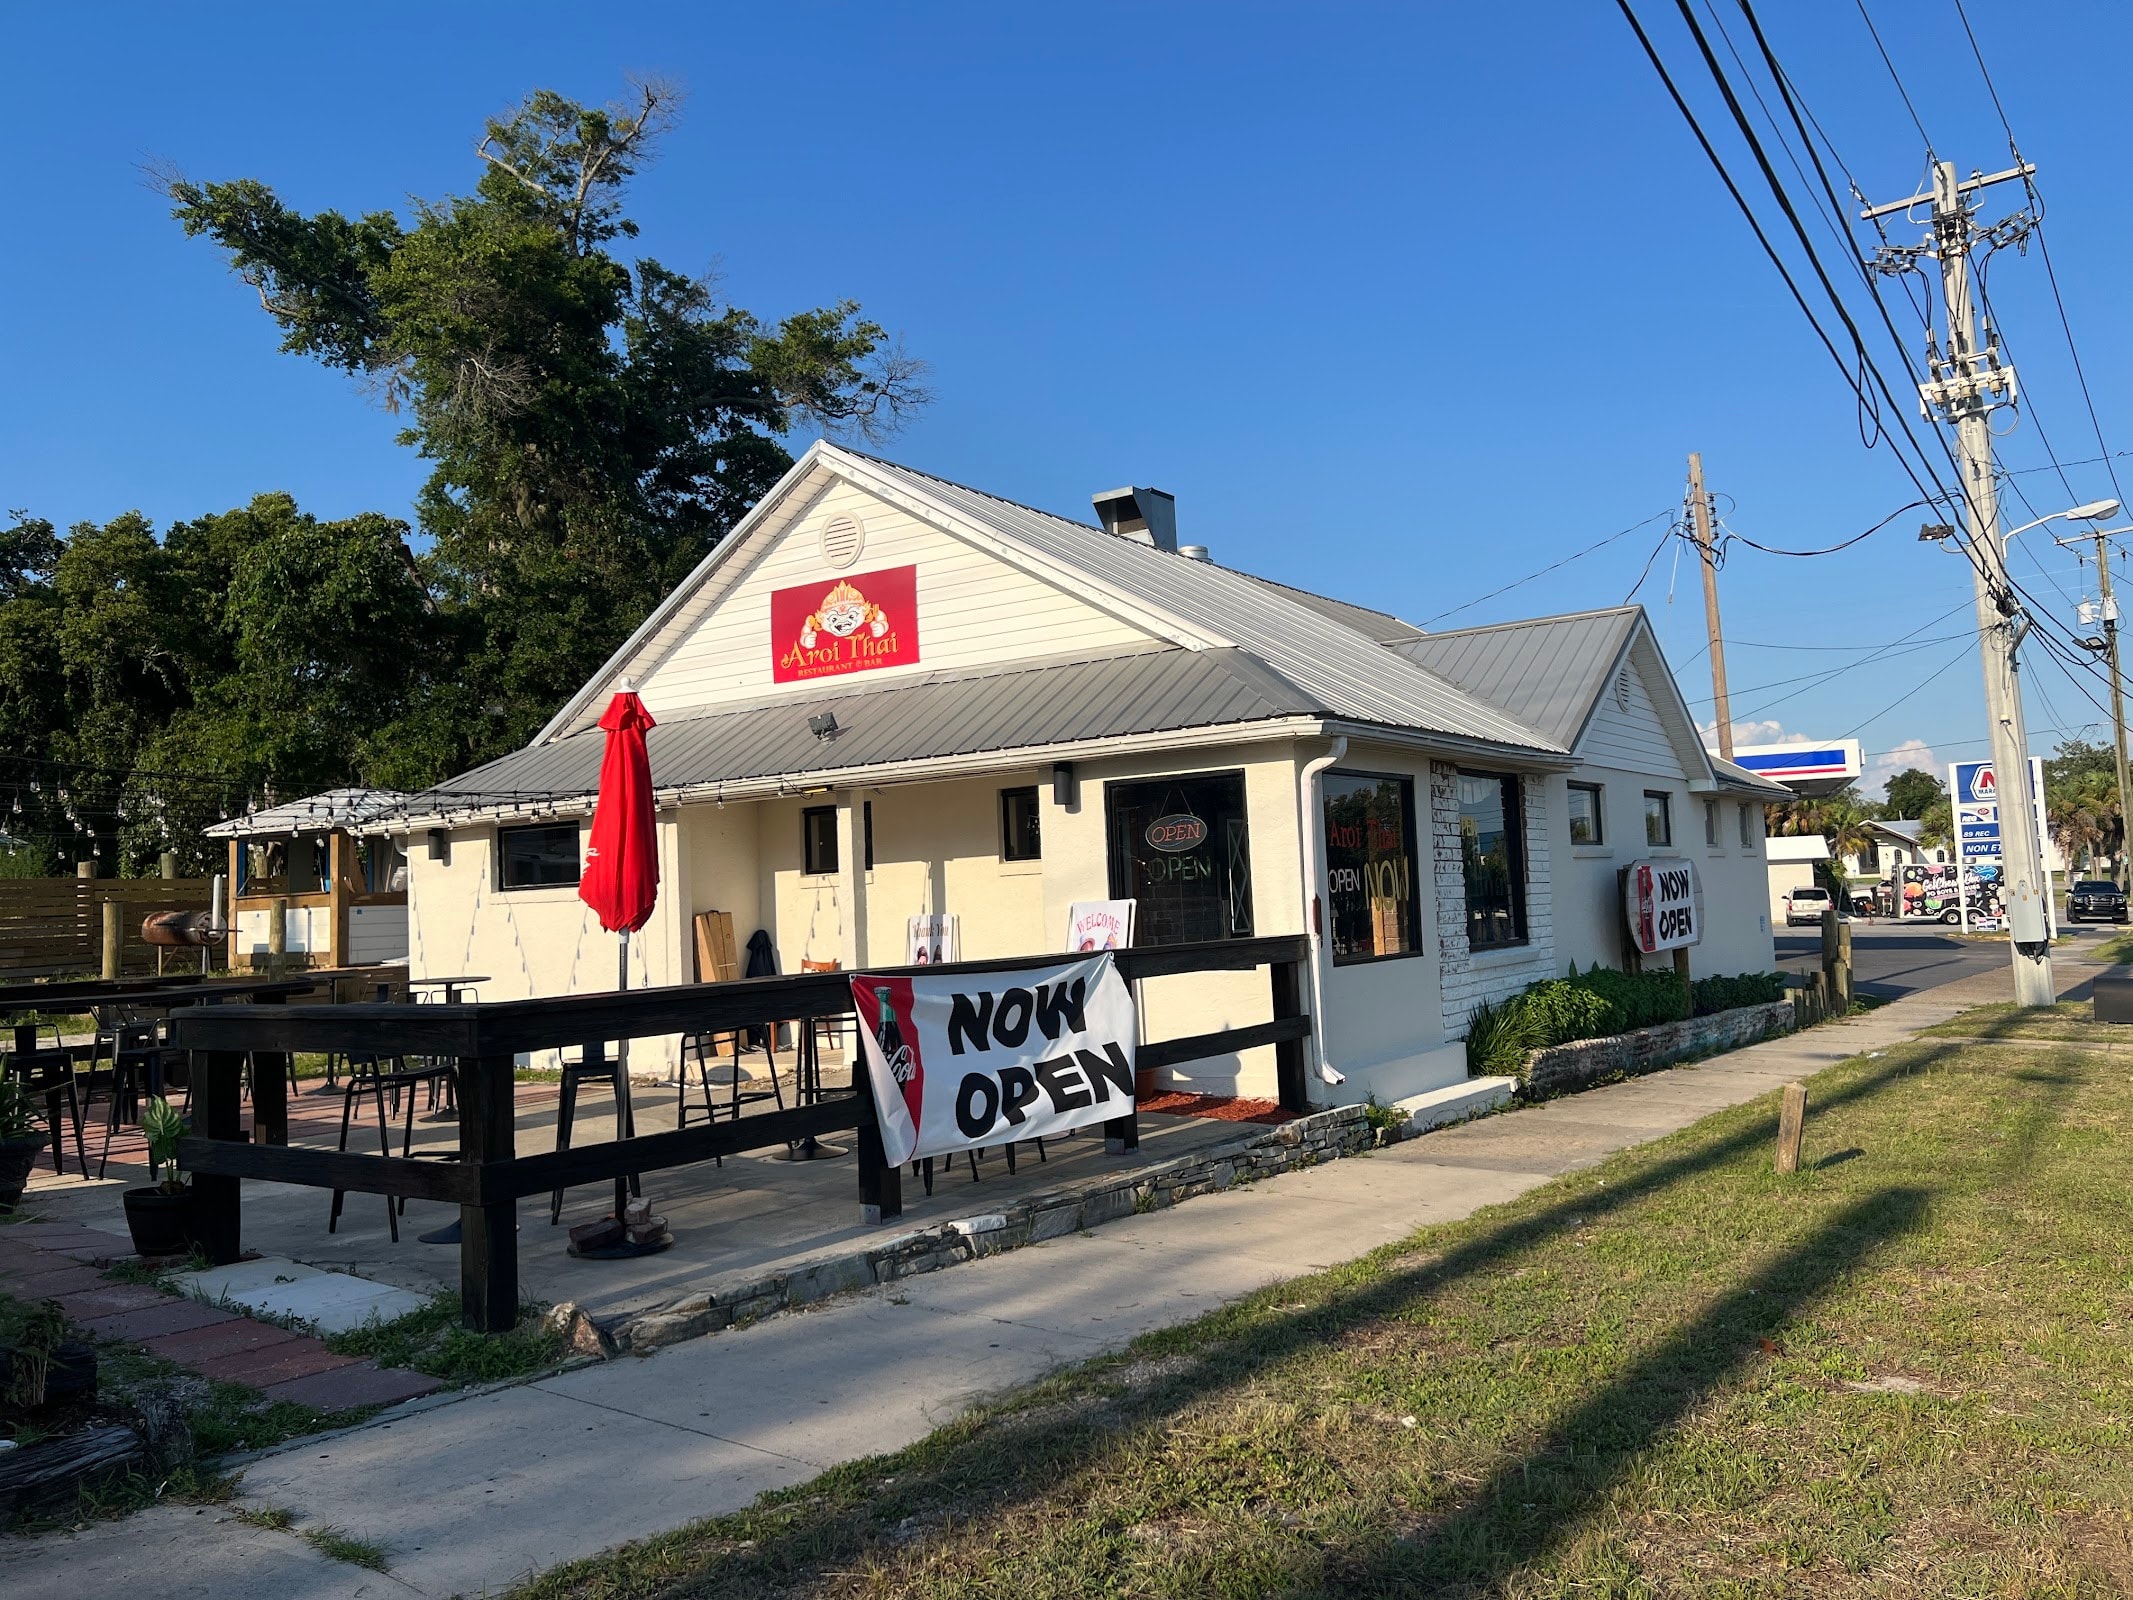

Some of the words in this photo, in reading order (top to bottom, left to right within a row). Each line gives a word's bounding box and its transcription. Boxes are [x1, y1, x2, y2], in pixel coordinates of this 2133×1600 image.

[780, 640, 840, 669] Aroi
[845, 632, 898, 659] Thai
[798, 662, 853, 677] RESTAURANT
[864, 657, 882, 667] BAR
[1151, 822, 1201, 843] OPEN
[1329, 820, 1361, 849] Aroi
[1966, 844, 1989, 853] NON
[1150, 855, 1211, 882] OPEN
[1328, 868, 1360, 893] OPEN
[1364, 856, 1409, 911] NOW
[1658, 869, 1689, 902] NOW
[912, 922, 935, 938] Thank
[936, 923, 949, 937] You
[1077, 912, 1120, 935] WELCOME
[1659, 906, 1692, 941] OPEN
[948, 976, 1087, 1055] NOW
[955, 1041, 1134, 1139] OPEN
